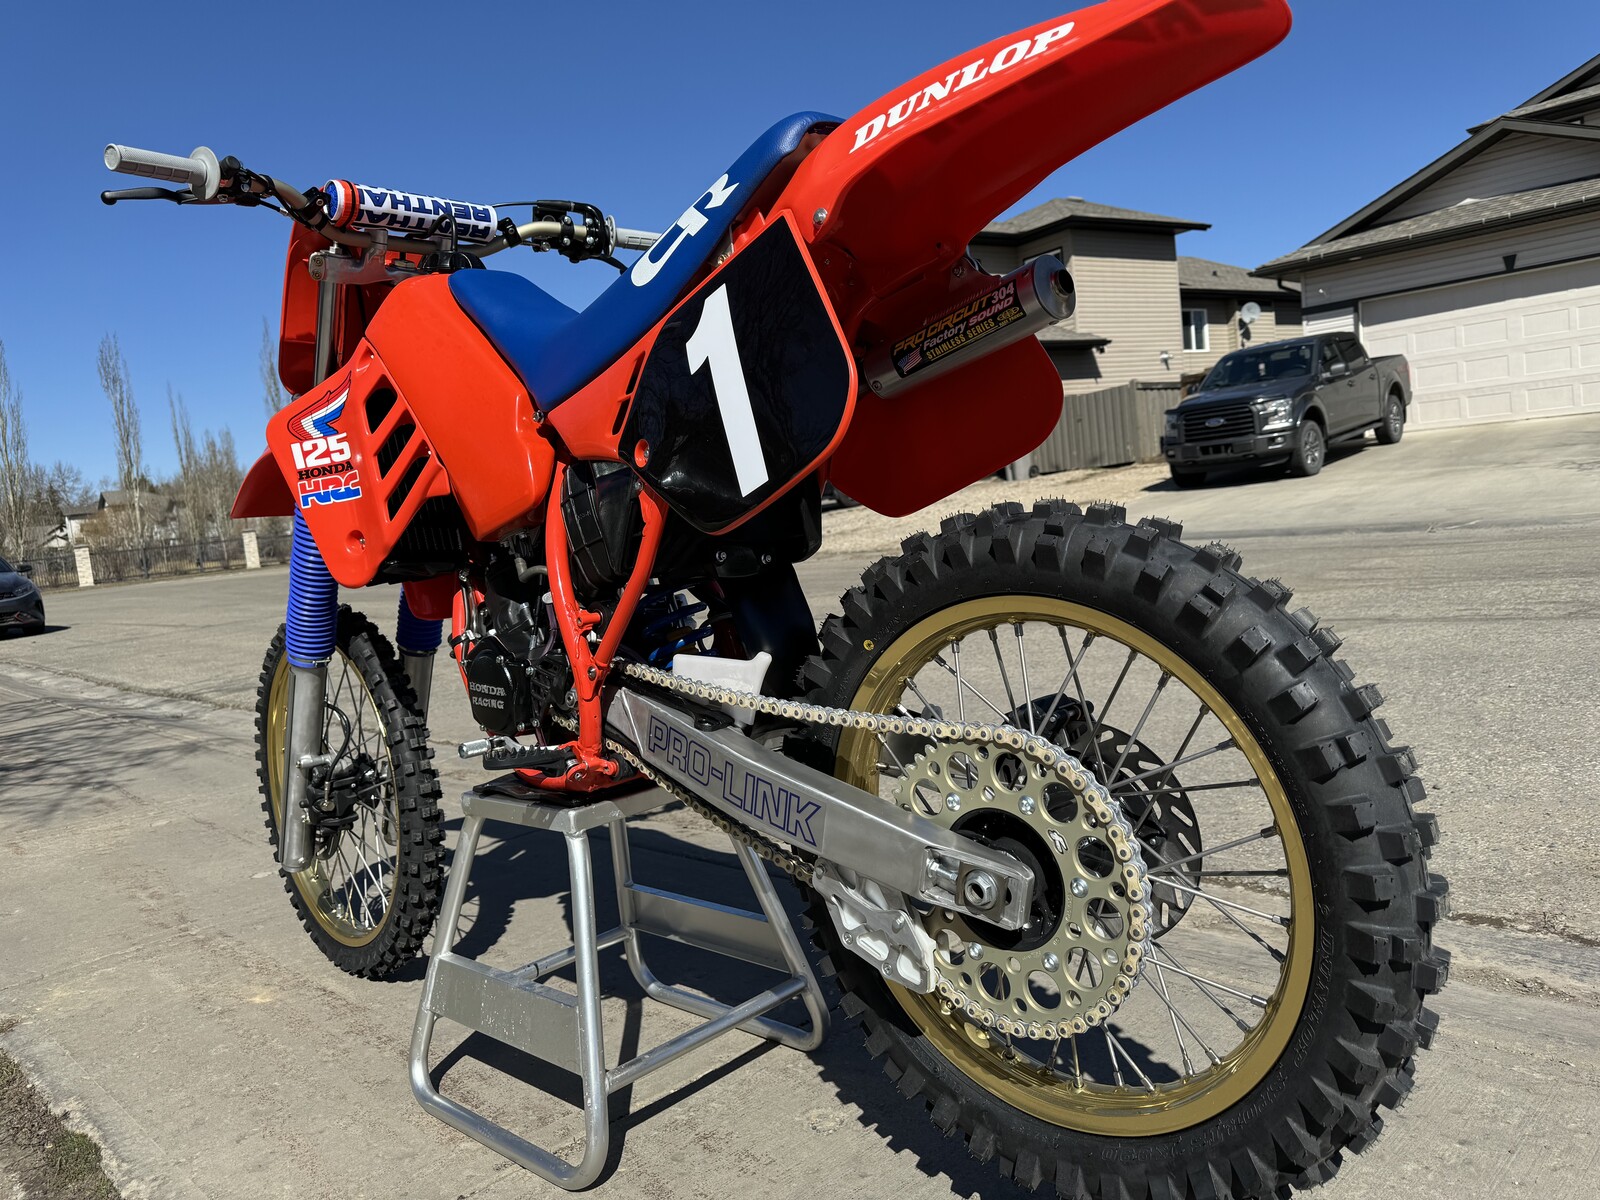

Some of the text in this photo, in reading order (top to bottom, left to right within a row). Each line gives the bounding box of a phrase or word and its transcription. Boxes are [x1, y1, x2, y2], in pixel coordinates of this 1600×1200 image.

[849, 22, 1074, 154] DUNLOP
[631, 173, 739, 286] CR
[893, 328, 927, 357] PRO
[927, 293, 992, 337] CIRCUIT
[991, 282, 1015, 304] 304
[923, 320, 967, 351] Factory
[968, 296, 1014, 326] SOUND
[926, 318, 995, 360] STAINLESS SERIES
[686, 283, 769, 497] 1
[291, 432, 351, 470] 125
[297, 461, 354, 480] HONDA
[297, 470, 362, 509] HRC
[469, 681, 507, 697] HONDA
[472, 696, 505, 710] RACING
[648, 715, 821, 847] PRO-LINK
[1291, 927, 1334, 1067] DUNLOP
